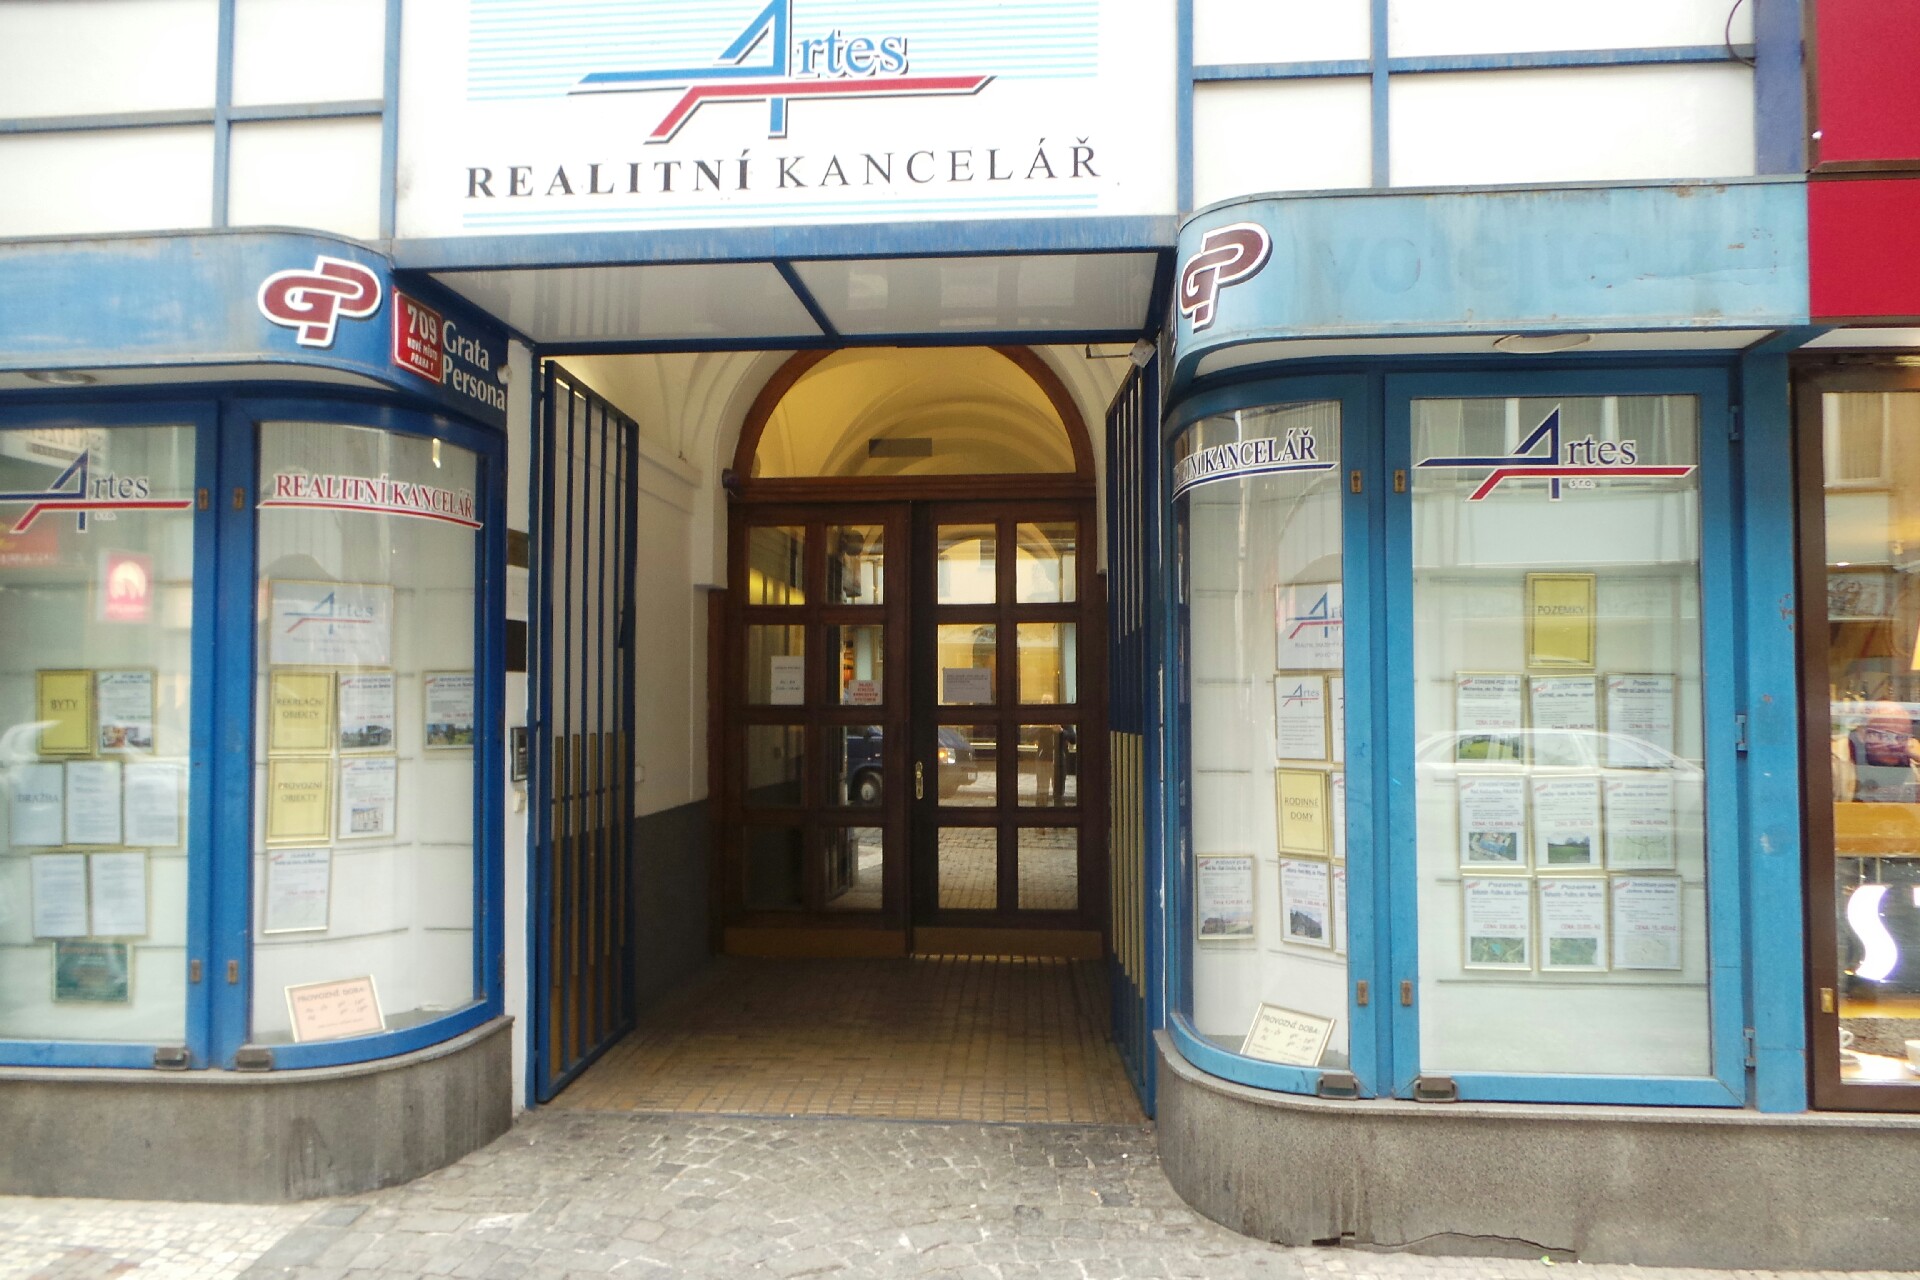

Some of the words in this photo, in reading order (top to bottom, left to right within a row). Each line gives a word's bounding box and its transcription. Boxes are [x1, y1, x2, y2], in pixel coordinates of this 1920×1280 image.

[465, 148, 752, 199] REALITNÍ
[774, 137, 1101, 189] KANCELÁŘ
[407, 303, 438, 346] 709
[407, 337, 422, 353] NOVÉ
[443, 320, 490, 372] Grata
[411, 352, 429, 369] PRAHA
[430, 361, 434, 372] 1
[443, 353, 507, 411] Persona
[1204, 427, 1318, 476] KANCELÁŘ
[1466, 404, 1637, 500] Artes
[10, 448, 150, 533] Artes
[275, 474, 388, 504] REALITNÍ
[391, 480, 474, 520] KANCELÁŘ
[1537, 605, 1585, 615] POZEMKY
[50, 699, 78, 712] BYTY
[1290, 811, 1314, 821] DOMY
[1262, 1013, 1297, 1029] PROVOZNÍ
[1298, 1023, 1319, 1035] DOBA
